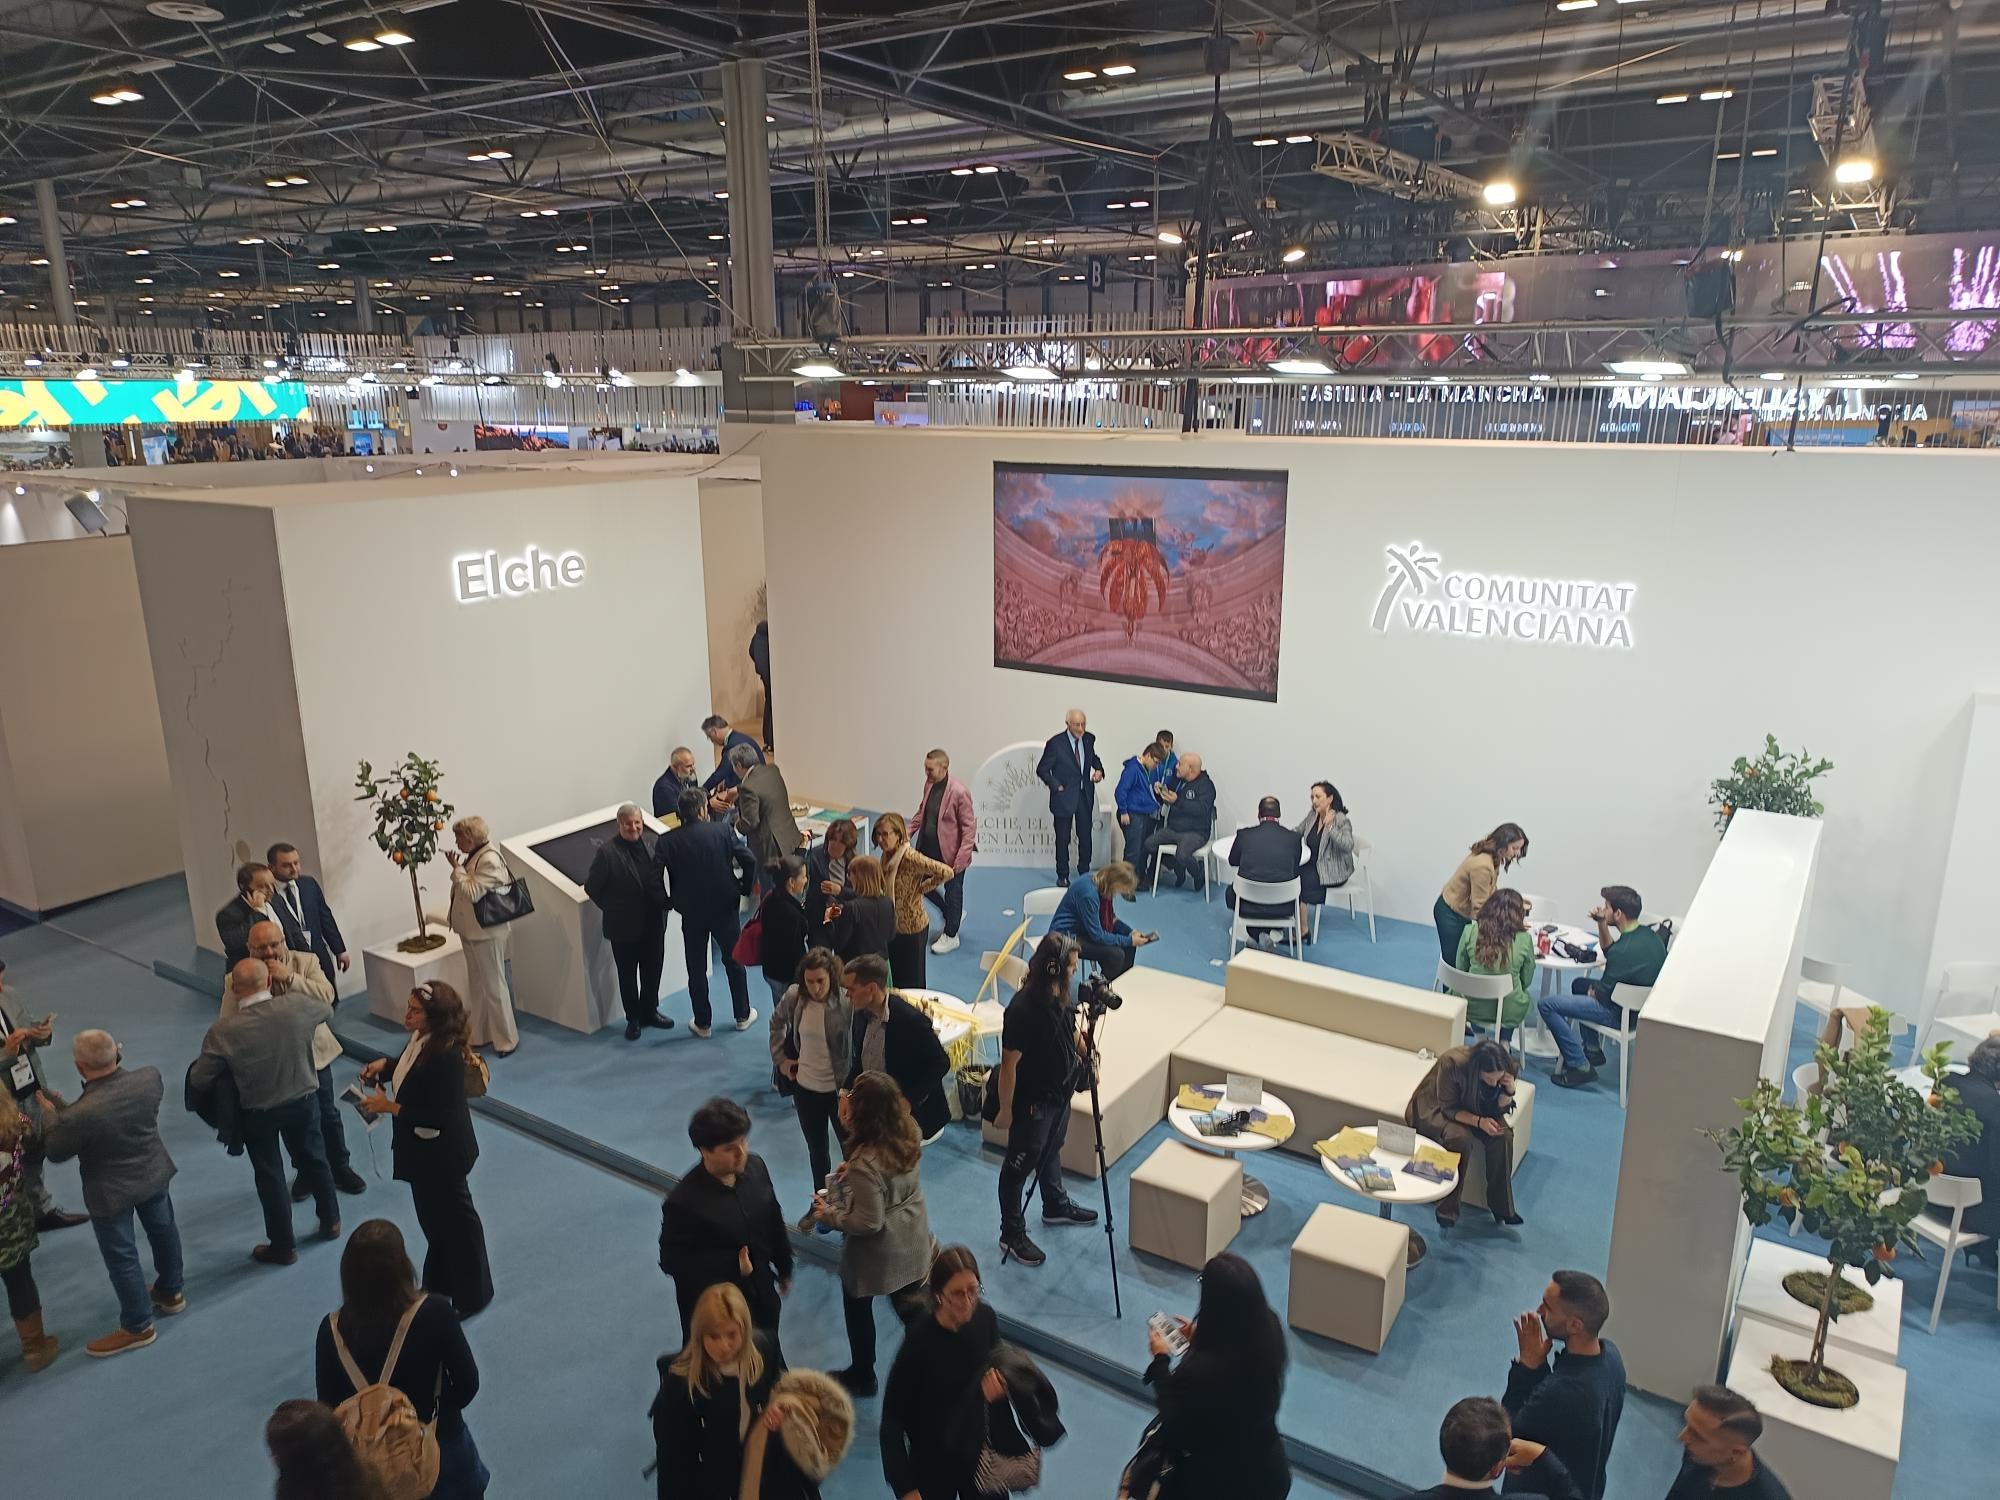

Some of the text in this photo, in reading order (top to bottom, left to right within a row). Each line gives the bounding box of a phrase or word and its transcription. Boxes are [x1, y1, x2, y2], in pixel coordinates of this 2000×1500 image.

[1092, 260, 1101, 288] B
[1441, 385, 1545, 403] MANCHA
[456, 548, 586, 601] Elche
[1442, 574, 1636, 612] COMUNITAT
[1401, 601, 1634, 649] VALENCIANA
[975, 816, 1048, 831] LCHE, EL
[977, 832, 998, 844] EN
[1003, 834, 1024, 845] LA
